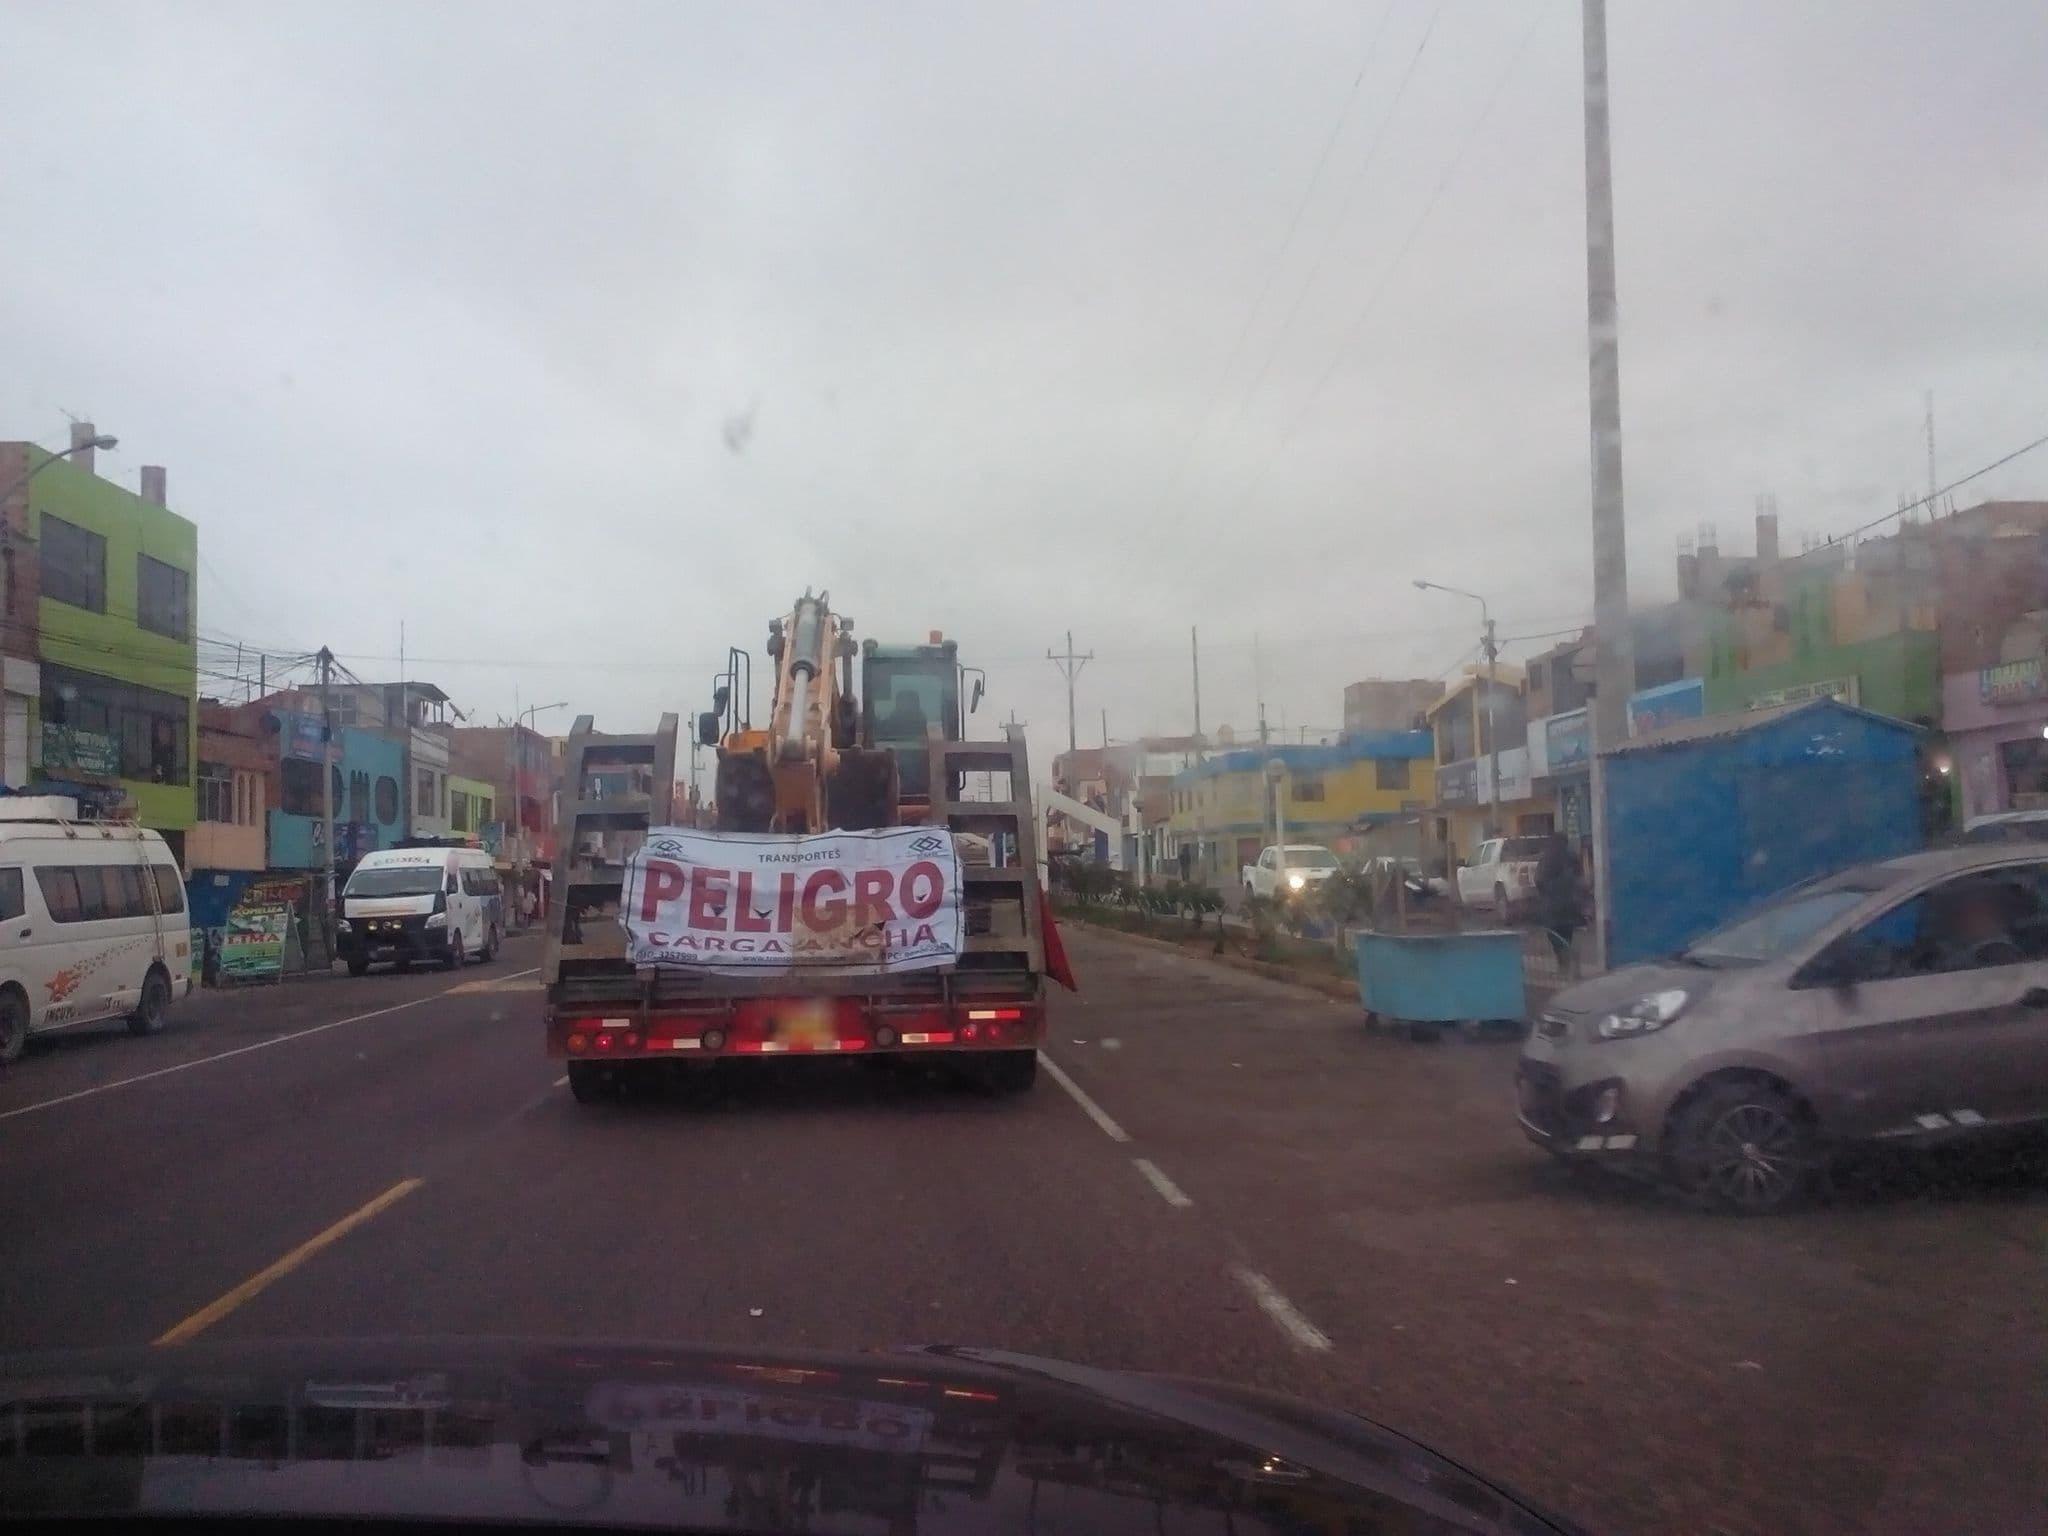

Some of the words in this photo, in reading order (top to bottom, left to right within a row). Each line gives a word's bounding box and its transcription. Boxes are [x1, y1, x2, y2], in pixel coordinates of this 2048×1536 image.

[759, 849, 841, 864] TRANSPORTES
[641, 859, 945, 934] PELIGRO
[227, 932, 281, 945] LIMA
[648, 931, 785, 953] CARGA
